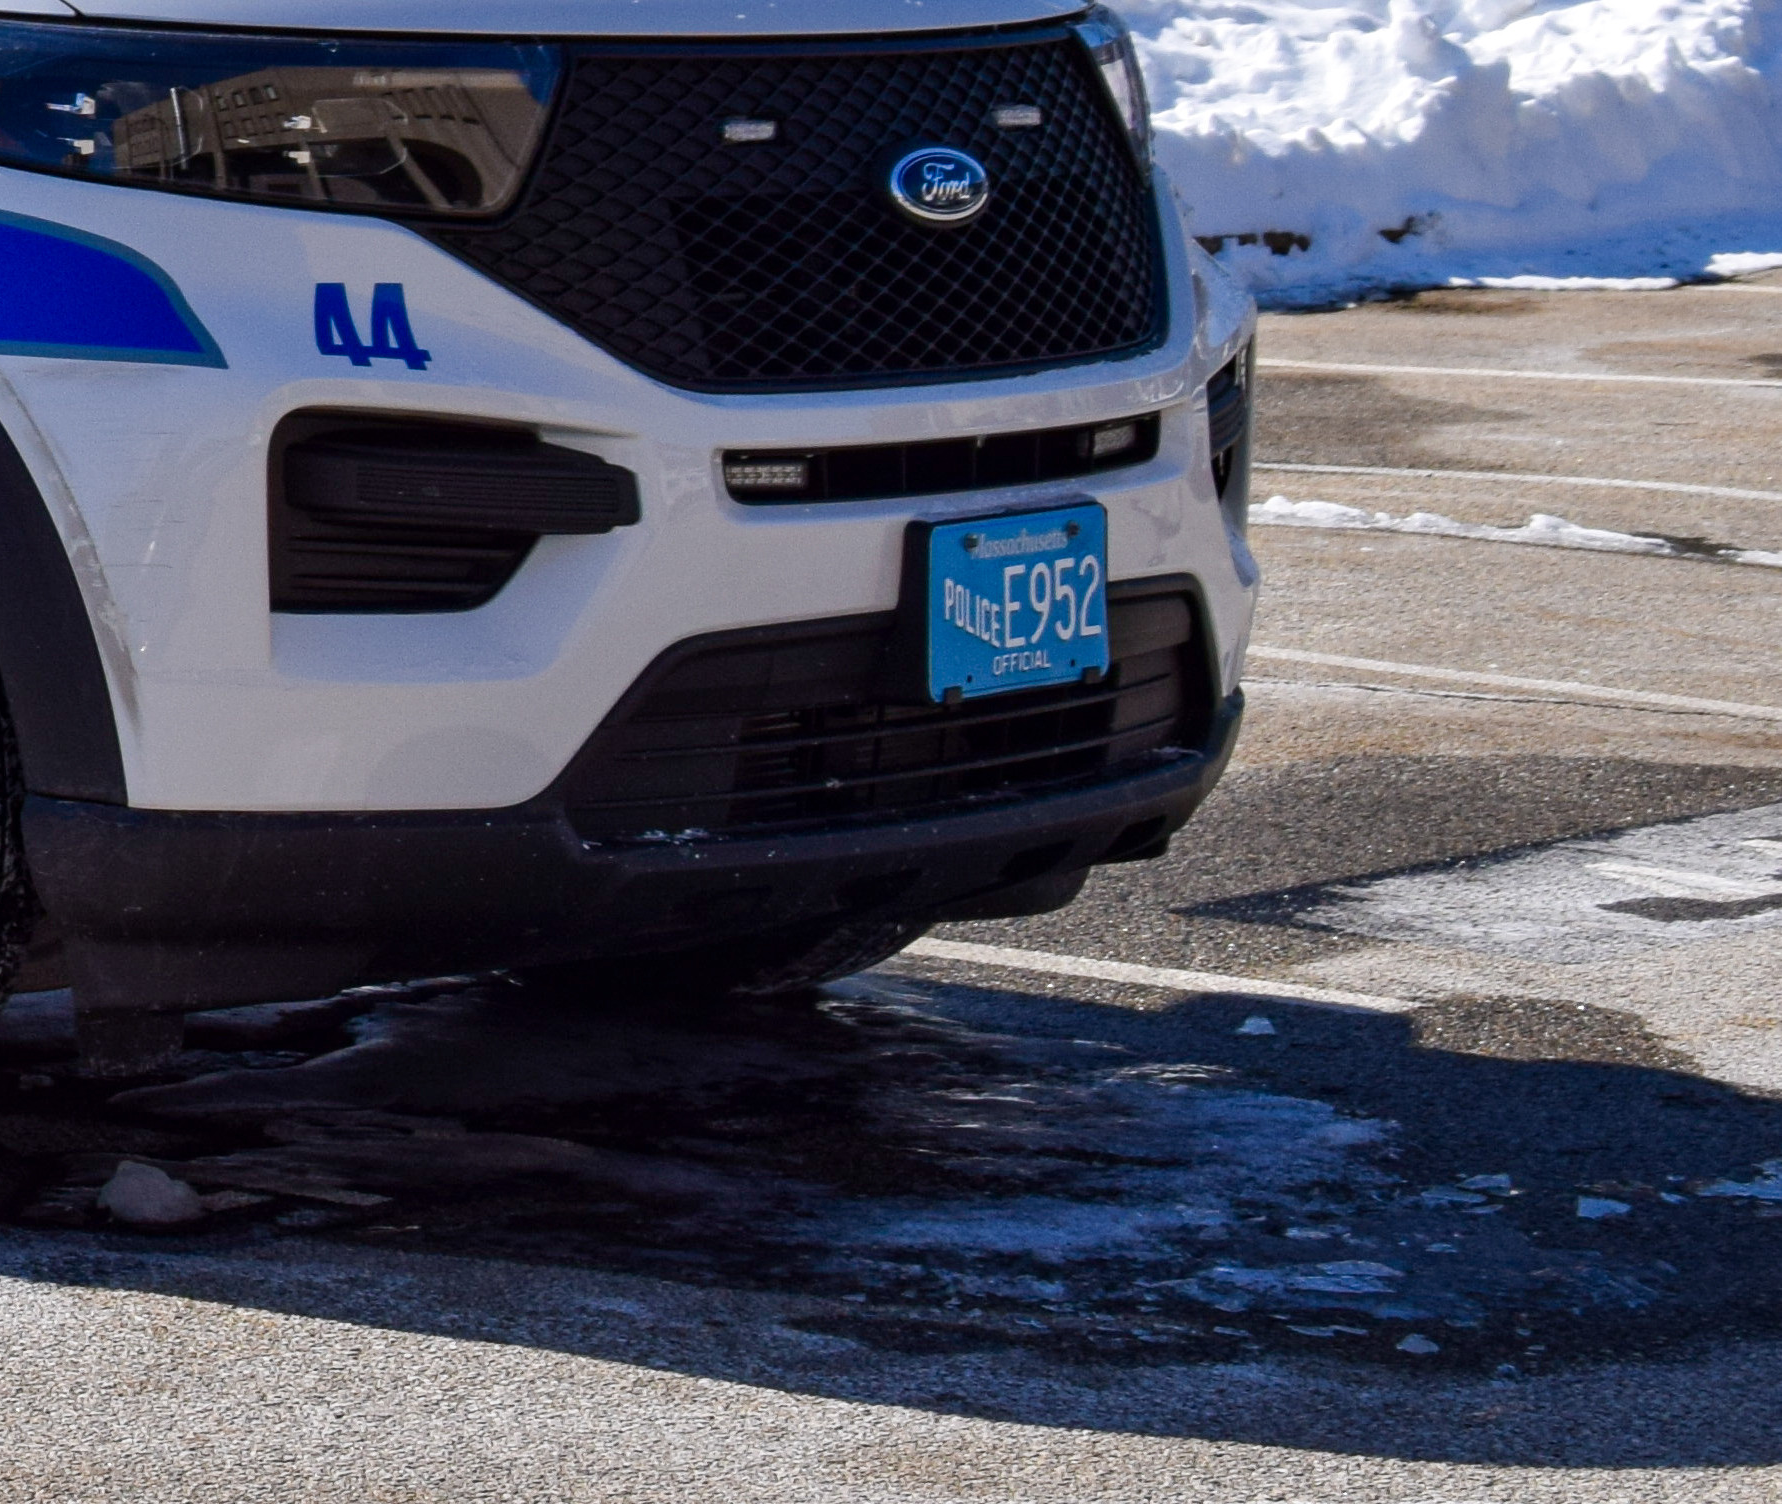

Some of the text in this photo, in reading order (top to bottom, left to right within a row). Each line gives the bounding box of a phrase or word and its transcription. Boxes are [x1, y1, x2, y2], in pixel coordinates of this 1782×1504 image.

[921, 162, 971, 202] Ford
[313, 282, 432, 371] 44
[943, 554, 1102, 648] POLICE E952
[993, 649, 1052, 676] OFFICIAL
